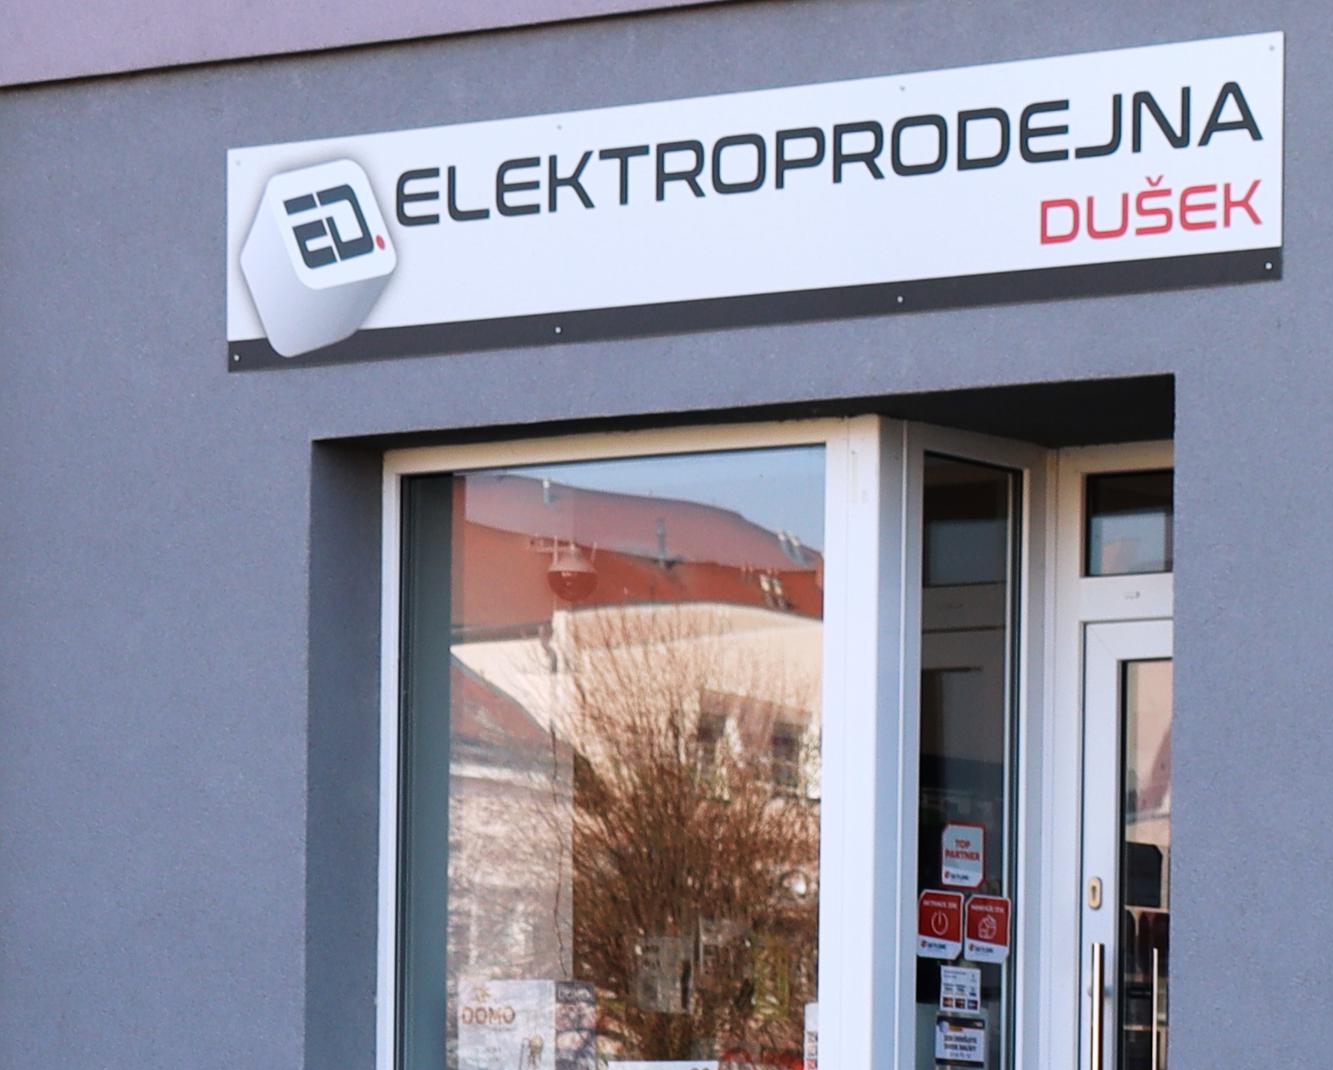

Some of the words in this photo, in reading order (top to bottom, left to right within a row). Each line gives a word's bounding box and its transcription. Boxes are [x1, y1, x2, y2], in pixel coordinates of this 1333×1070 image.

[395, 81, 1263, 227] ELEKTROPRODEJNA
[1040, 175, 1263, 245] DUŠEK
[462, 1006, 516, 1024] DOMO
